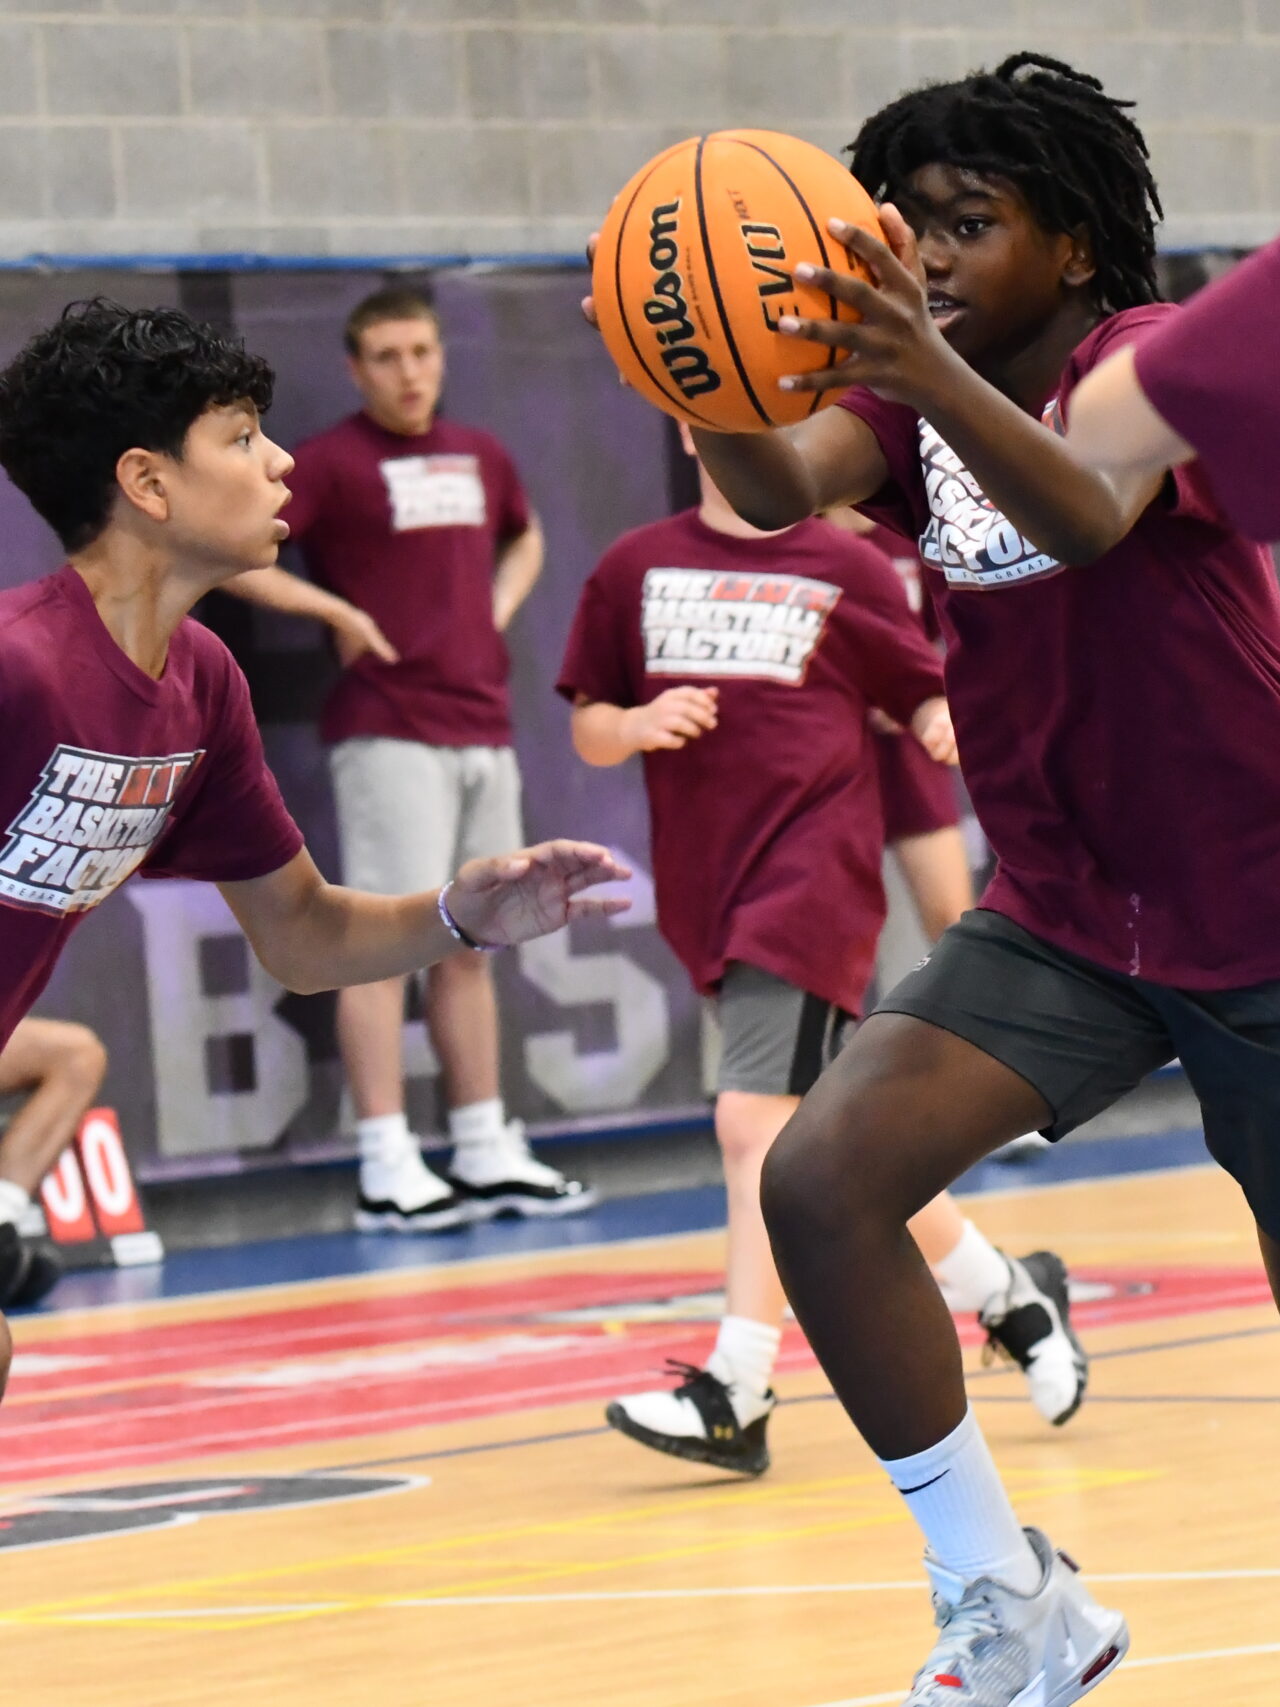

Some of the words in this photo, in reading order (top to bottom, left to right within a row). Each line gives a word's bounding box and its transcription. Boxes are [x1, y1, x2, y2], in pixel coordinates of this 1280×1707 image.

[643, 197, 722, 400] Wilson
[741, 221, 801, 332] EVO
[648, 572, 713, 601] THE
[48, 752, 124, 804] THE
